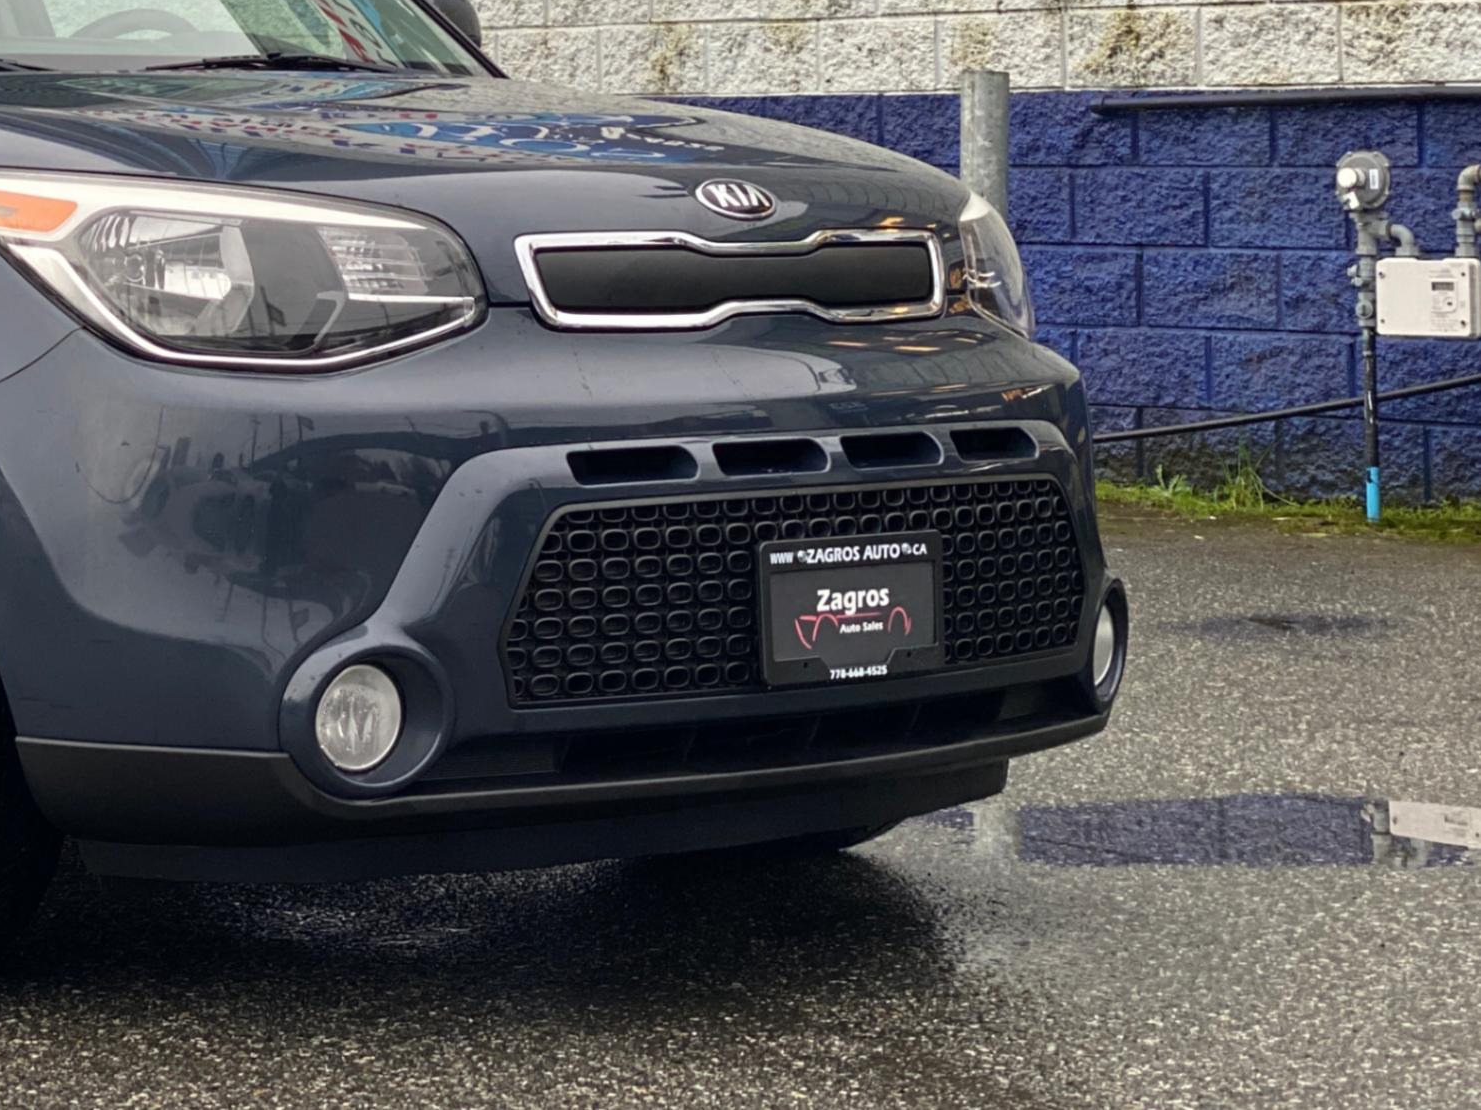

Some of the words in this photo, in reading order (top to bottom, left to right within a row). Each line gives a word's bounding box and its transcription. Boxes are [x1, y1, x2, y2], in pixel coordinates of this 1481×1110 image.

[704, 183, 771, 208] KIA
[769, 551, 794, 564] WWW
[806, 545, 860, 564] ZAGROS
[863, 543, 901, 561] AUTO
[912, 543, 928, 556] CA
[816, 588, 890, 614] Zagros
[839, 622, 861, 634] Auto
[862, 620, 884, 633] Sales
